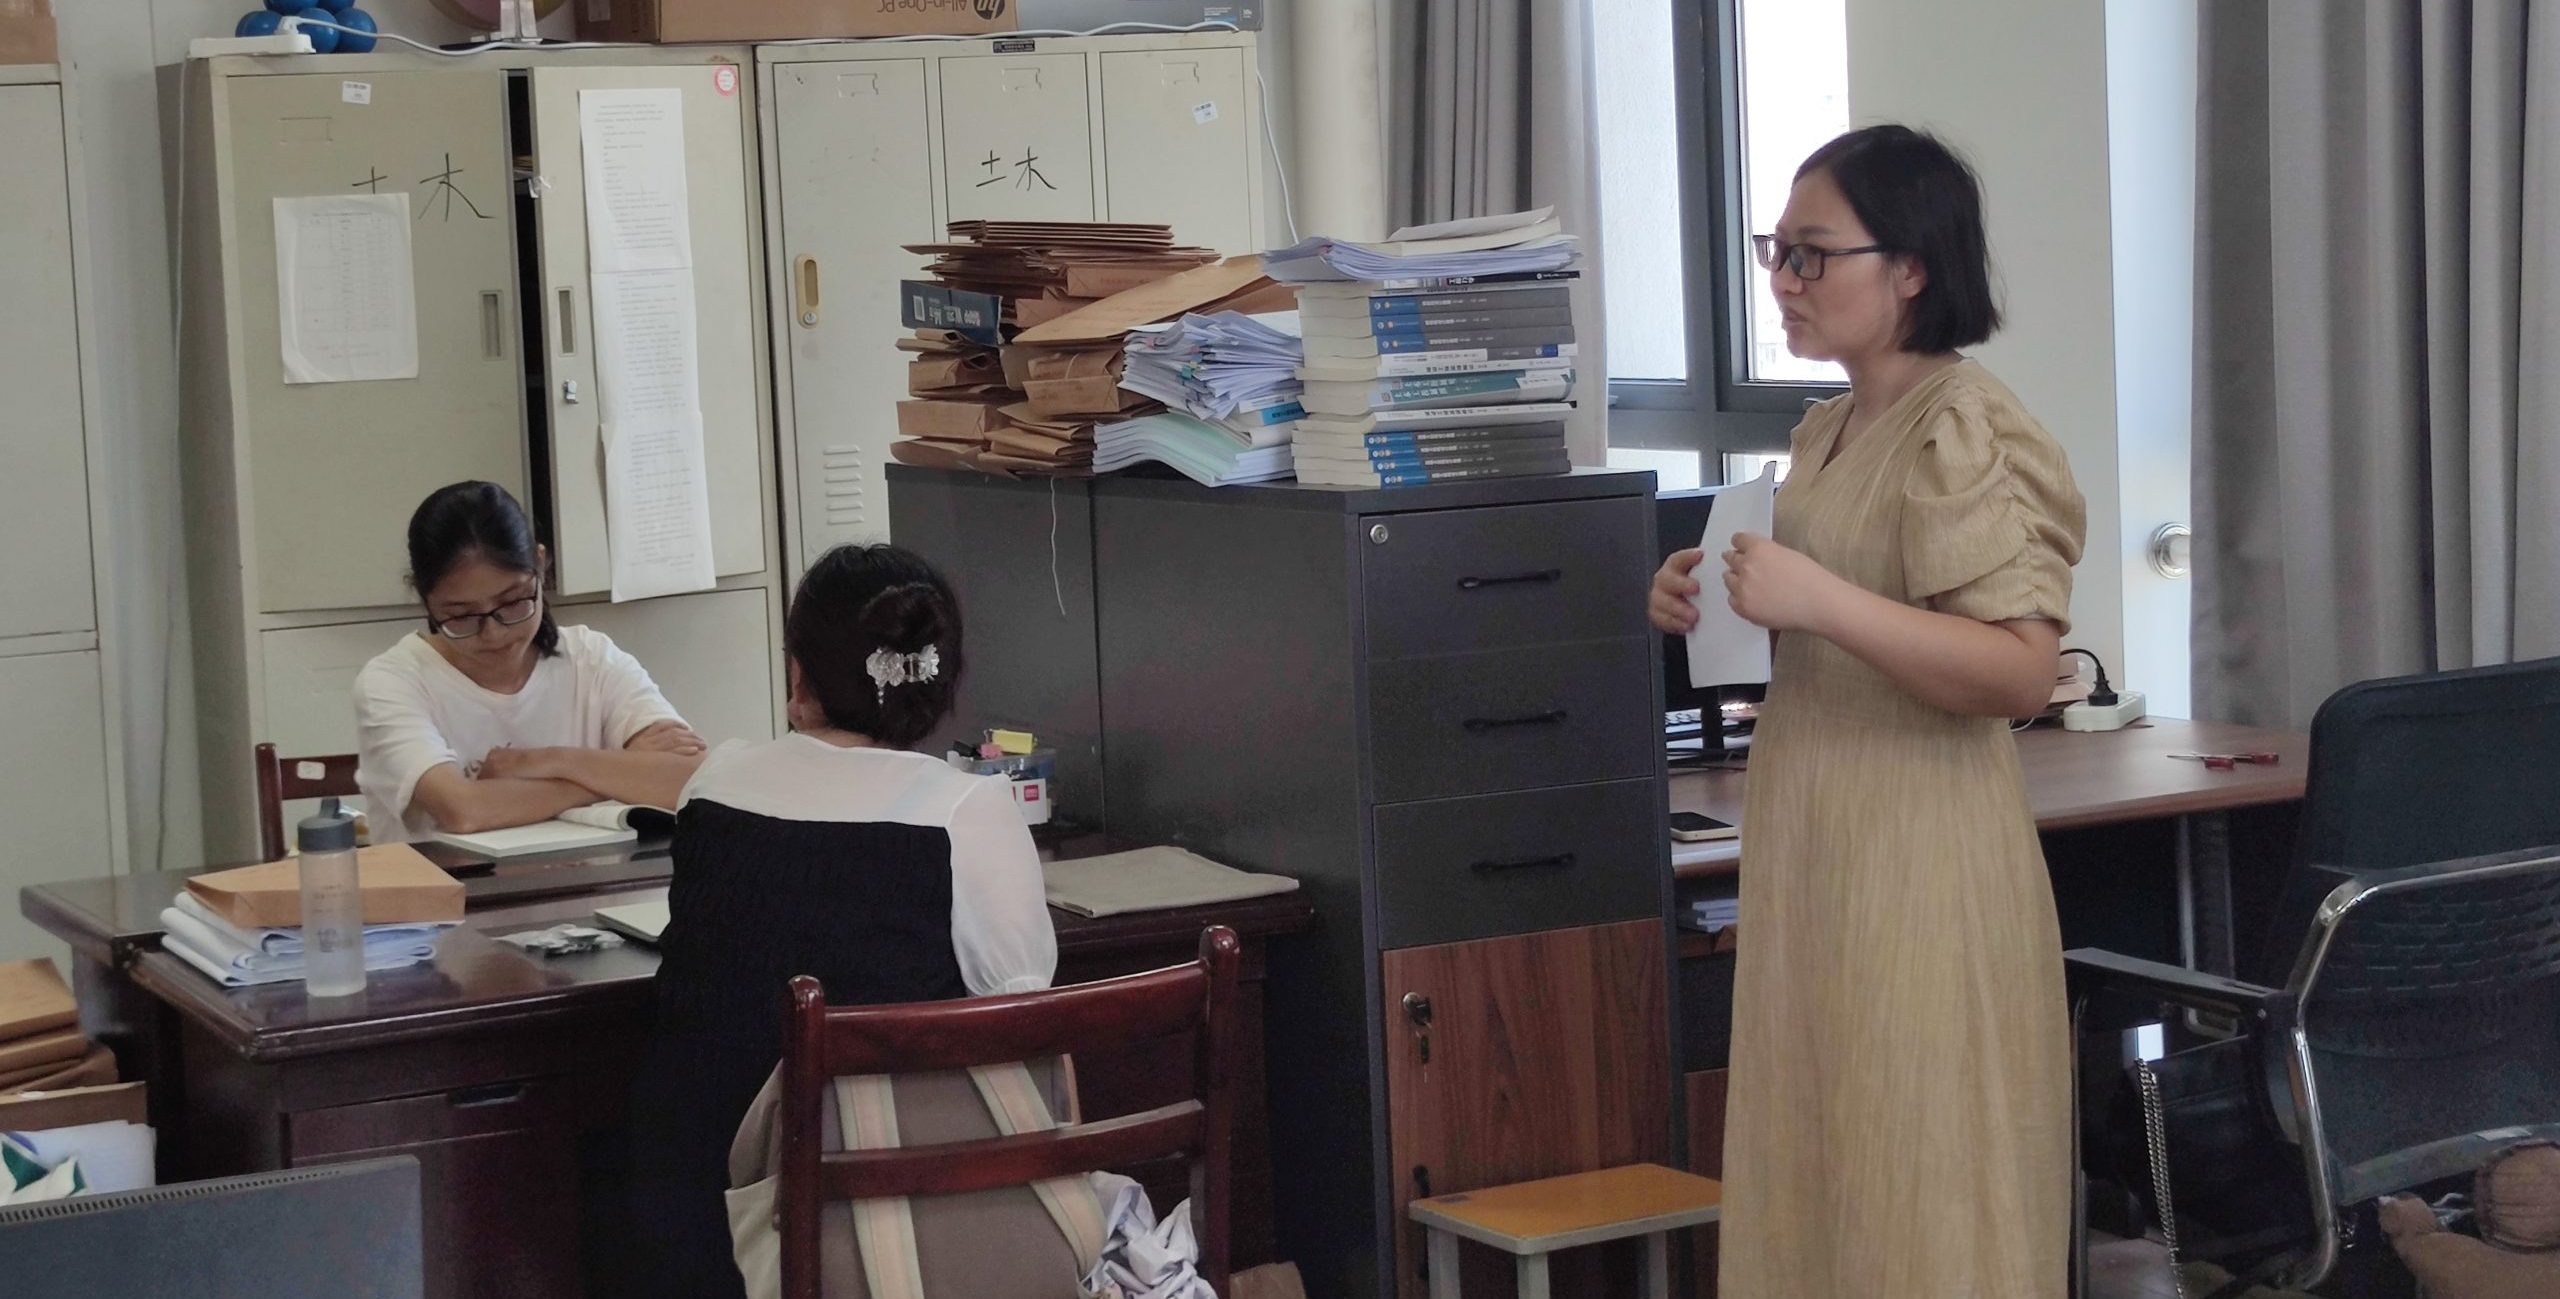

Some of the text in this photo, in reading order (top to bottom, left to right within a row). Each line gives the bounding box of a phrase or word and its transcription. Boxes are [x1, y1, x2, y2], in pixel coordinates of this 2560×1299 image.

[877, 0, 896, 13] PC
[899, 0, 967, 13] All-in-One
[976, 146, 1057, 191] 土木
